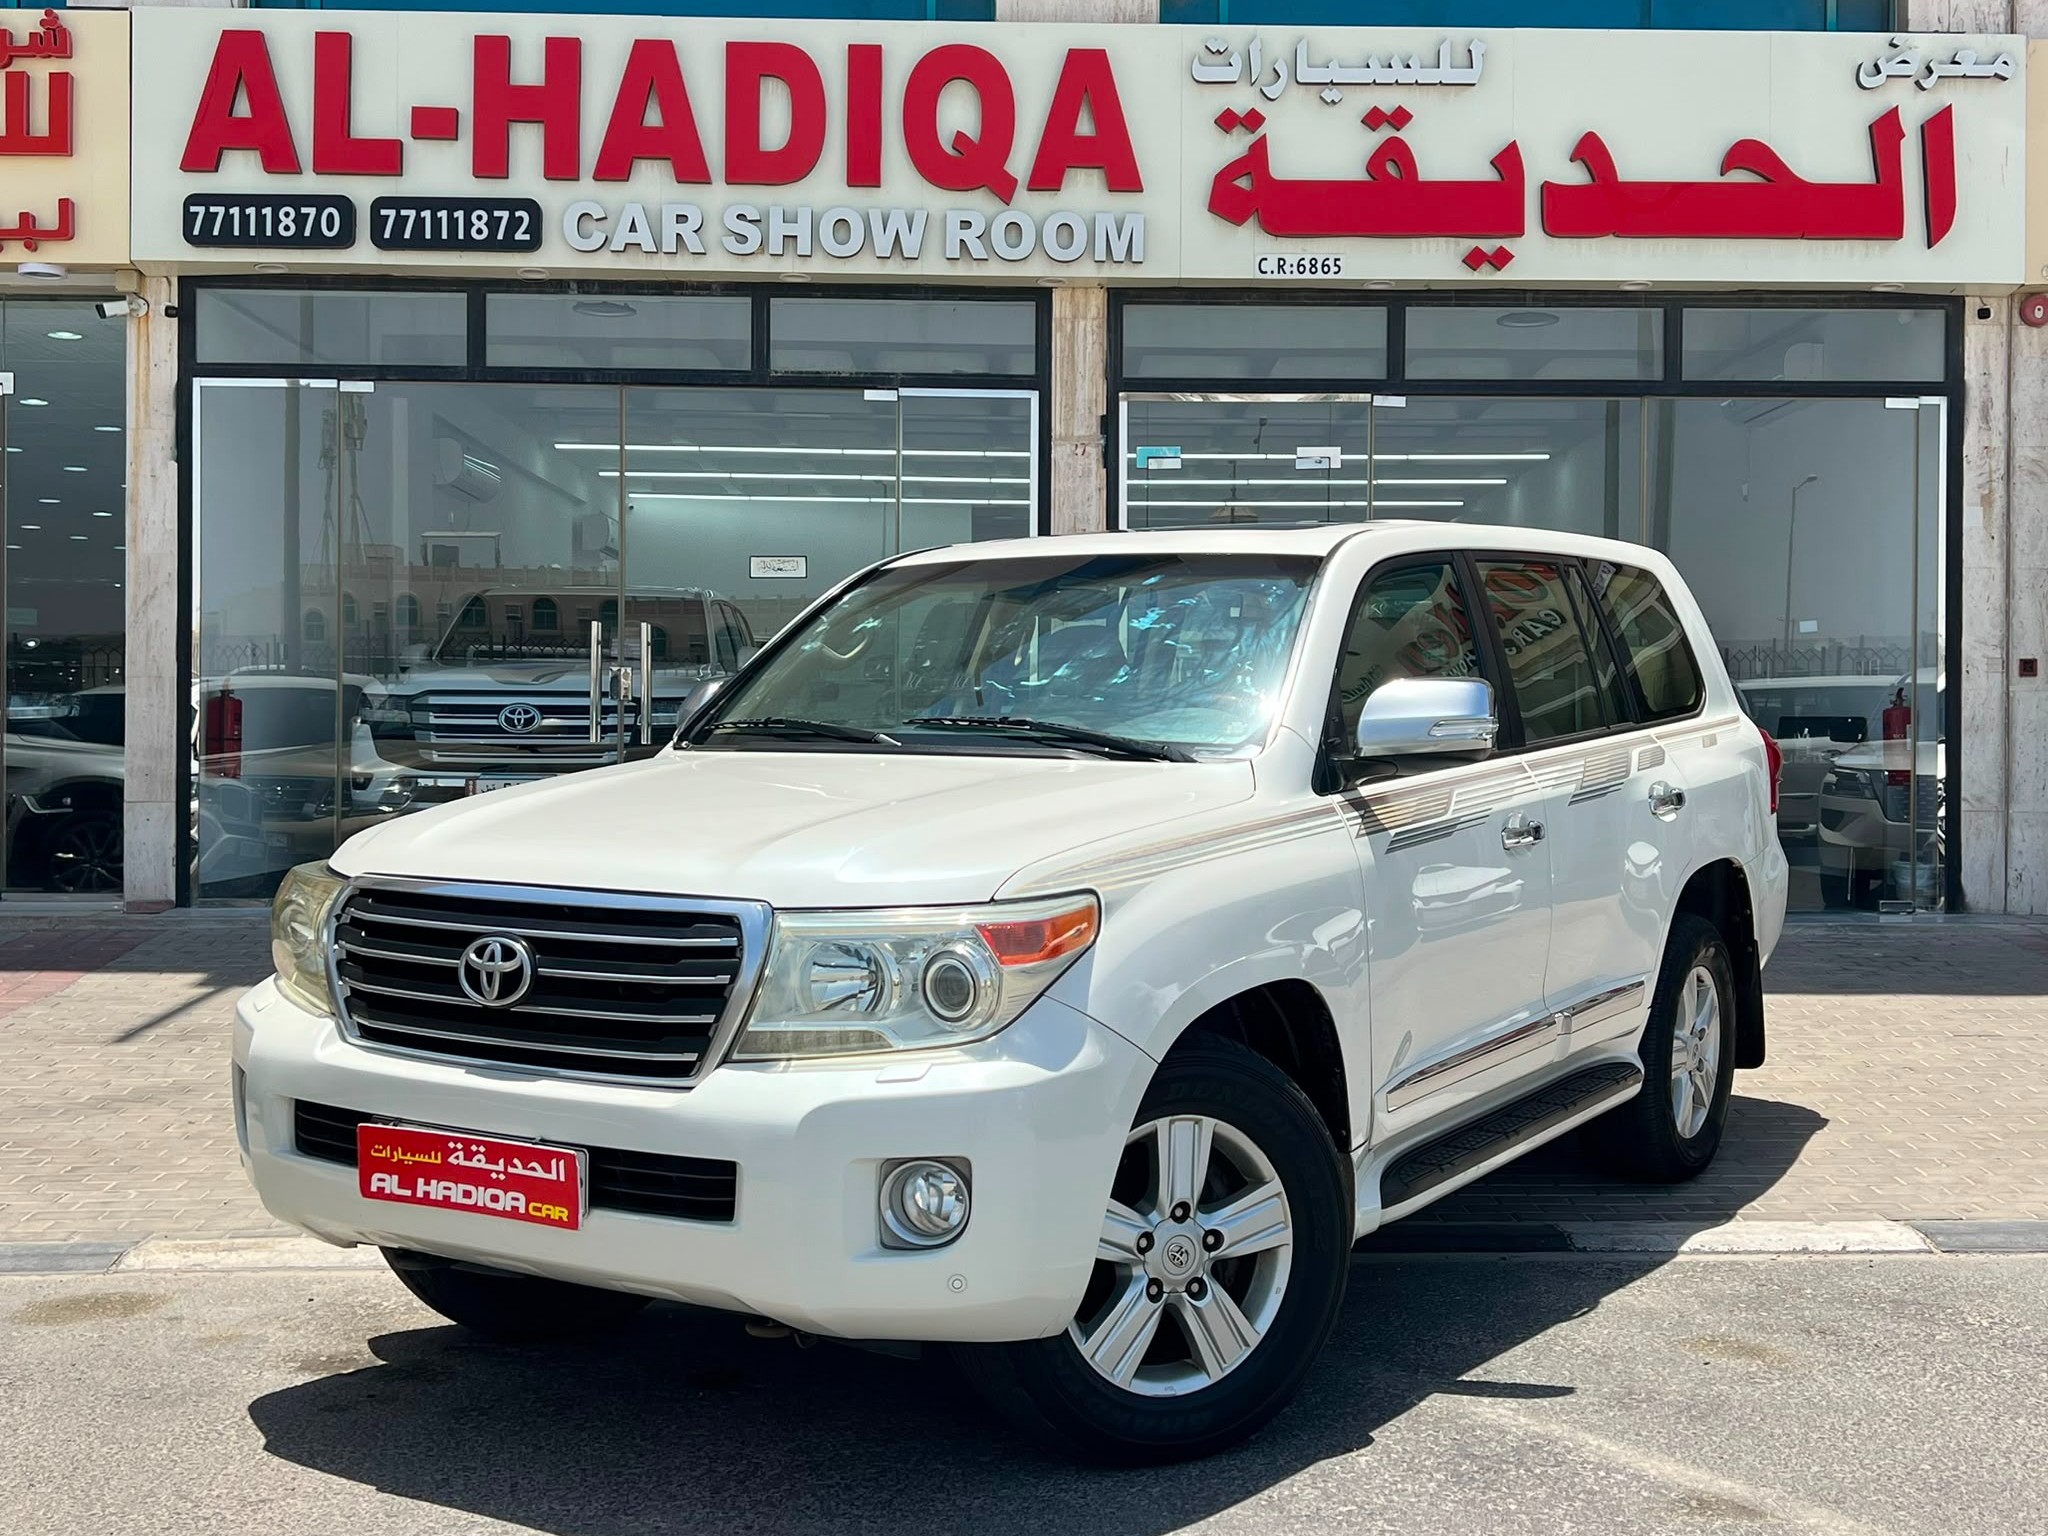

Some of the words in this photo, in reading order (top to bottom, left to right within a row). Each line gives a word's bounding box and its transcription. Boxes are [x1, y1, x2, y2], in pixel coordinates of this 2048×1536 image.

[1191, 35, 1487, 106] للسيارات
[1855, 36, 2017, 91] معرض
[180, 29, 1145, 205] AL-HADIQA
[1208, 103, 1957, 272] الحديقة
[188, 205, 342, 238] 77111870
[379, 208, 532, 241] 77111872
[563, 200, 707, 254] CAR
[721, 204, 929, 260] SHOW
[944, 209, 1146, 264] ROOM
[1257, 256, 1342, 275] C.R:6865
[370, 1144, 442, 1166] للسيارات
[447, 1141, 566, 1182] الحديقة
[370, 1172, 412, 1197] AL
[416, 1177, 527, 1214] HADIQA
[528, 1202, 569, 1222] CAR
